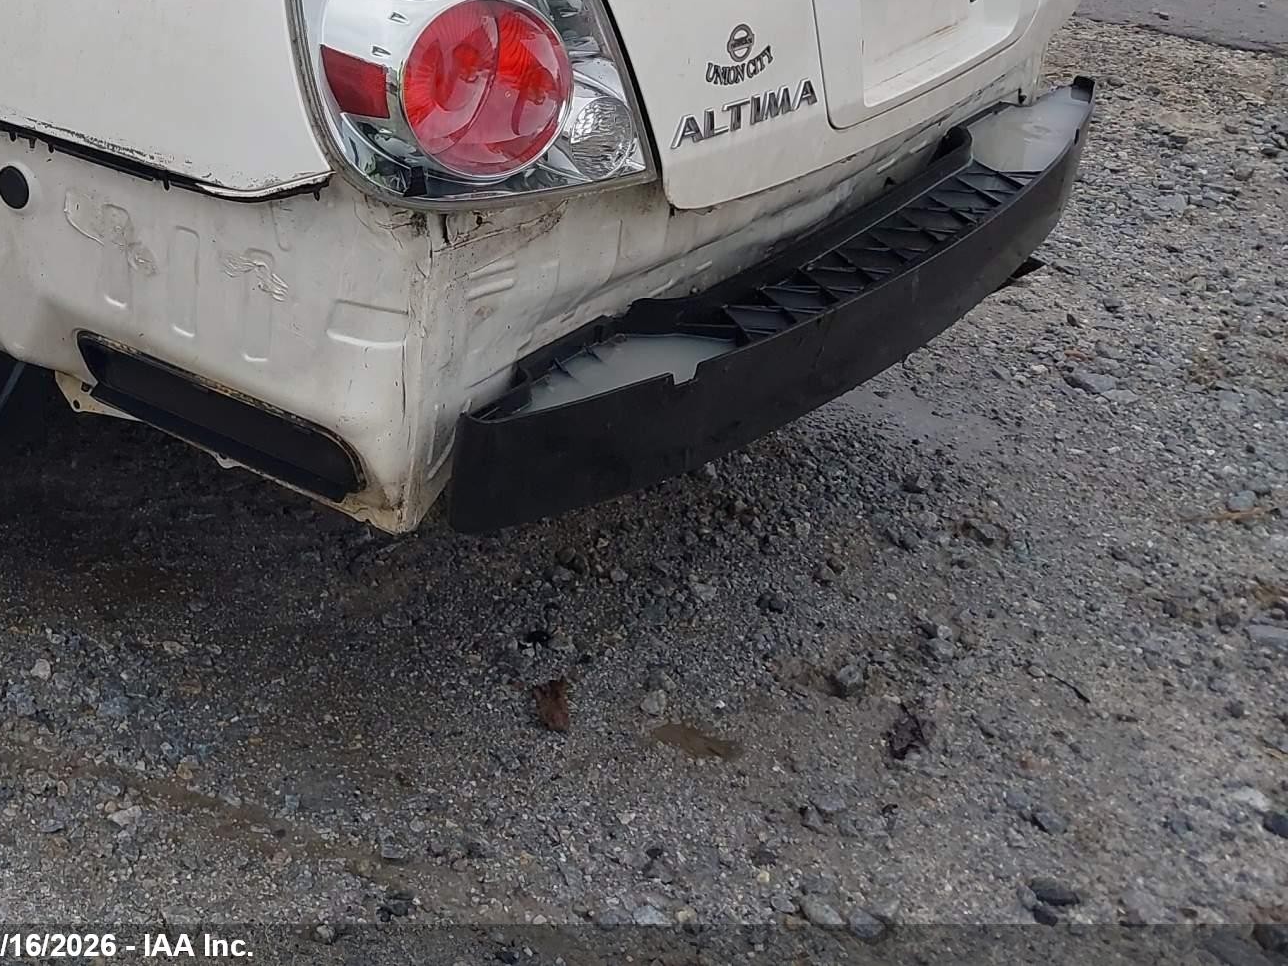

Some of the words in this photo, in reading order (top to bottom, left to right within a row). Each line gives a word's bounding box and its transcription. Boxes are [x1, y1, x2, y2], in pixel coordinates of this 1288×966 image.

[705, 62, 746, 85] UNION
[746, 45, 774, 79] CITY
[670, 77, 818, 149] ALTIMA
